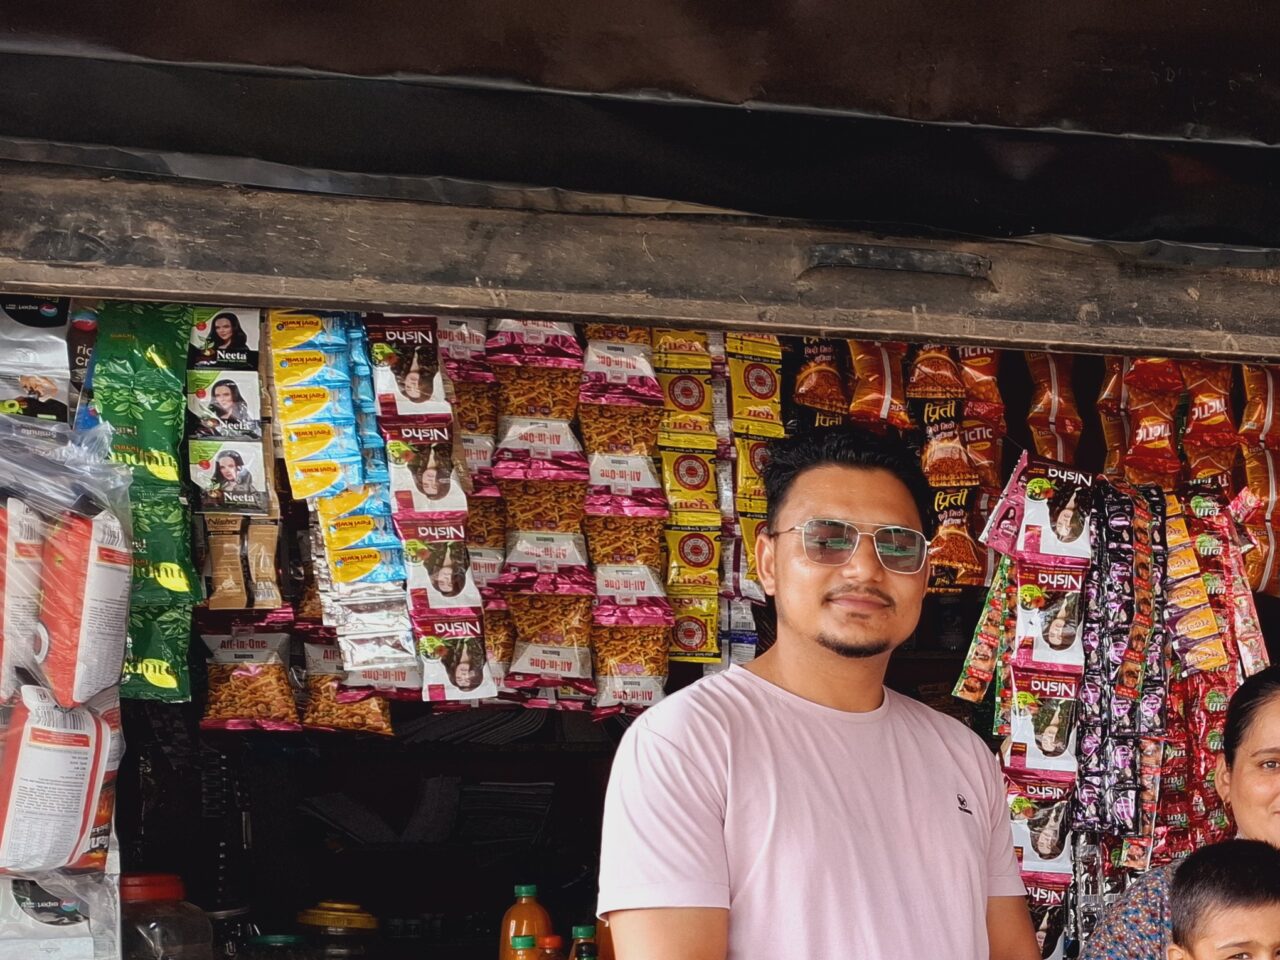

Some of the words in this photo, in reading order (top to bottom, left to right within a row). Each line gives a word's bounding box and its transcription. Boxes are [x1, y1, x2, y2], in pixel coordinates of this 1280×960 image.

[386, 331, 433, 344] Nisha
[217, 350, 246, 360] Neeta
[401, 428, 448, 441] Nisha
[465, 449, 488, 461] All-in
[600, 469, 641, 482] All-in-One
[1047, 468, 1092, 487] Nisha
[224, 491, 254, 501] Neeta
[418, 525, 465, 538] Nisha
[473, 562, 496, 573] All-in
[605, 580, 646, 591] All-in-One
[1038, 573, 1083, 589] Nisha
[434, 621, 480, 634] Nisha
[220, 639, 267, 649] All-in-One
[530, 659, 573, 672] All-in-One
[362, 670, 406, 682] All-in-One
[1030, 680, 1076, 697] Nisha
[612, 690, 653, 701] All-in-One
